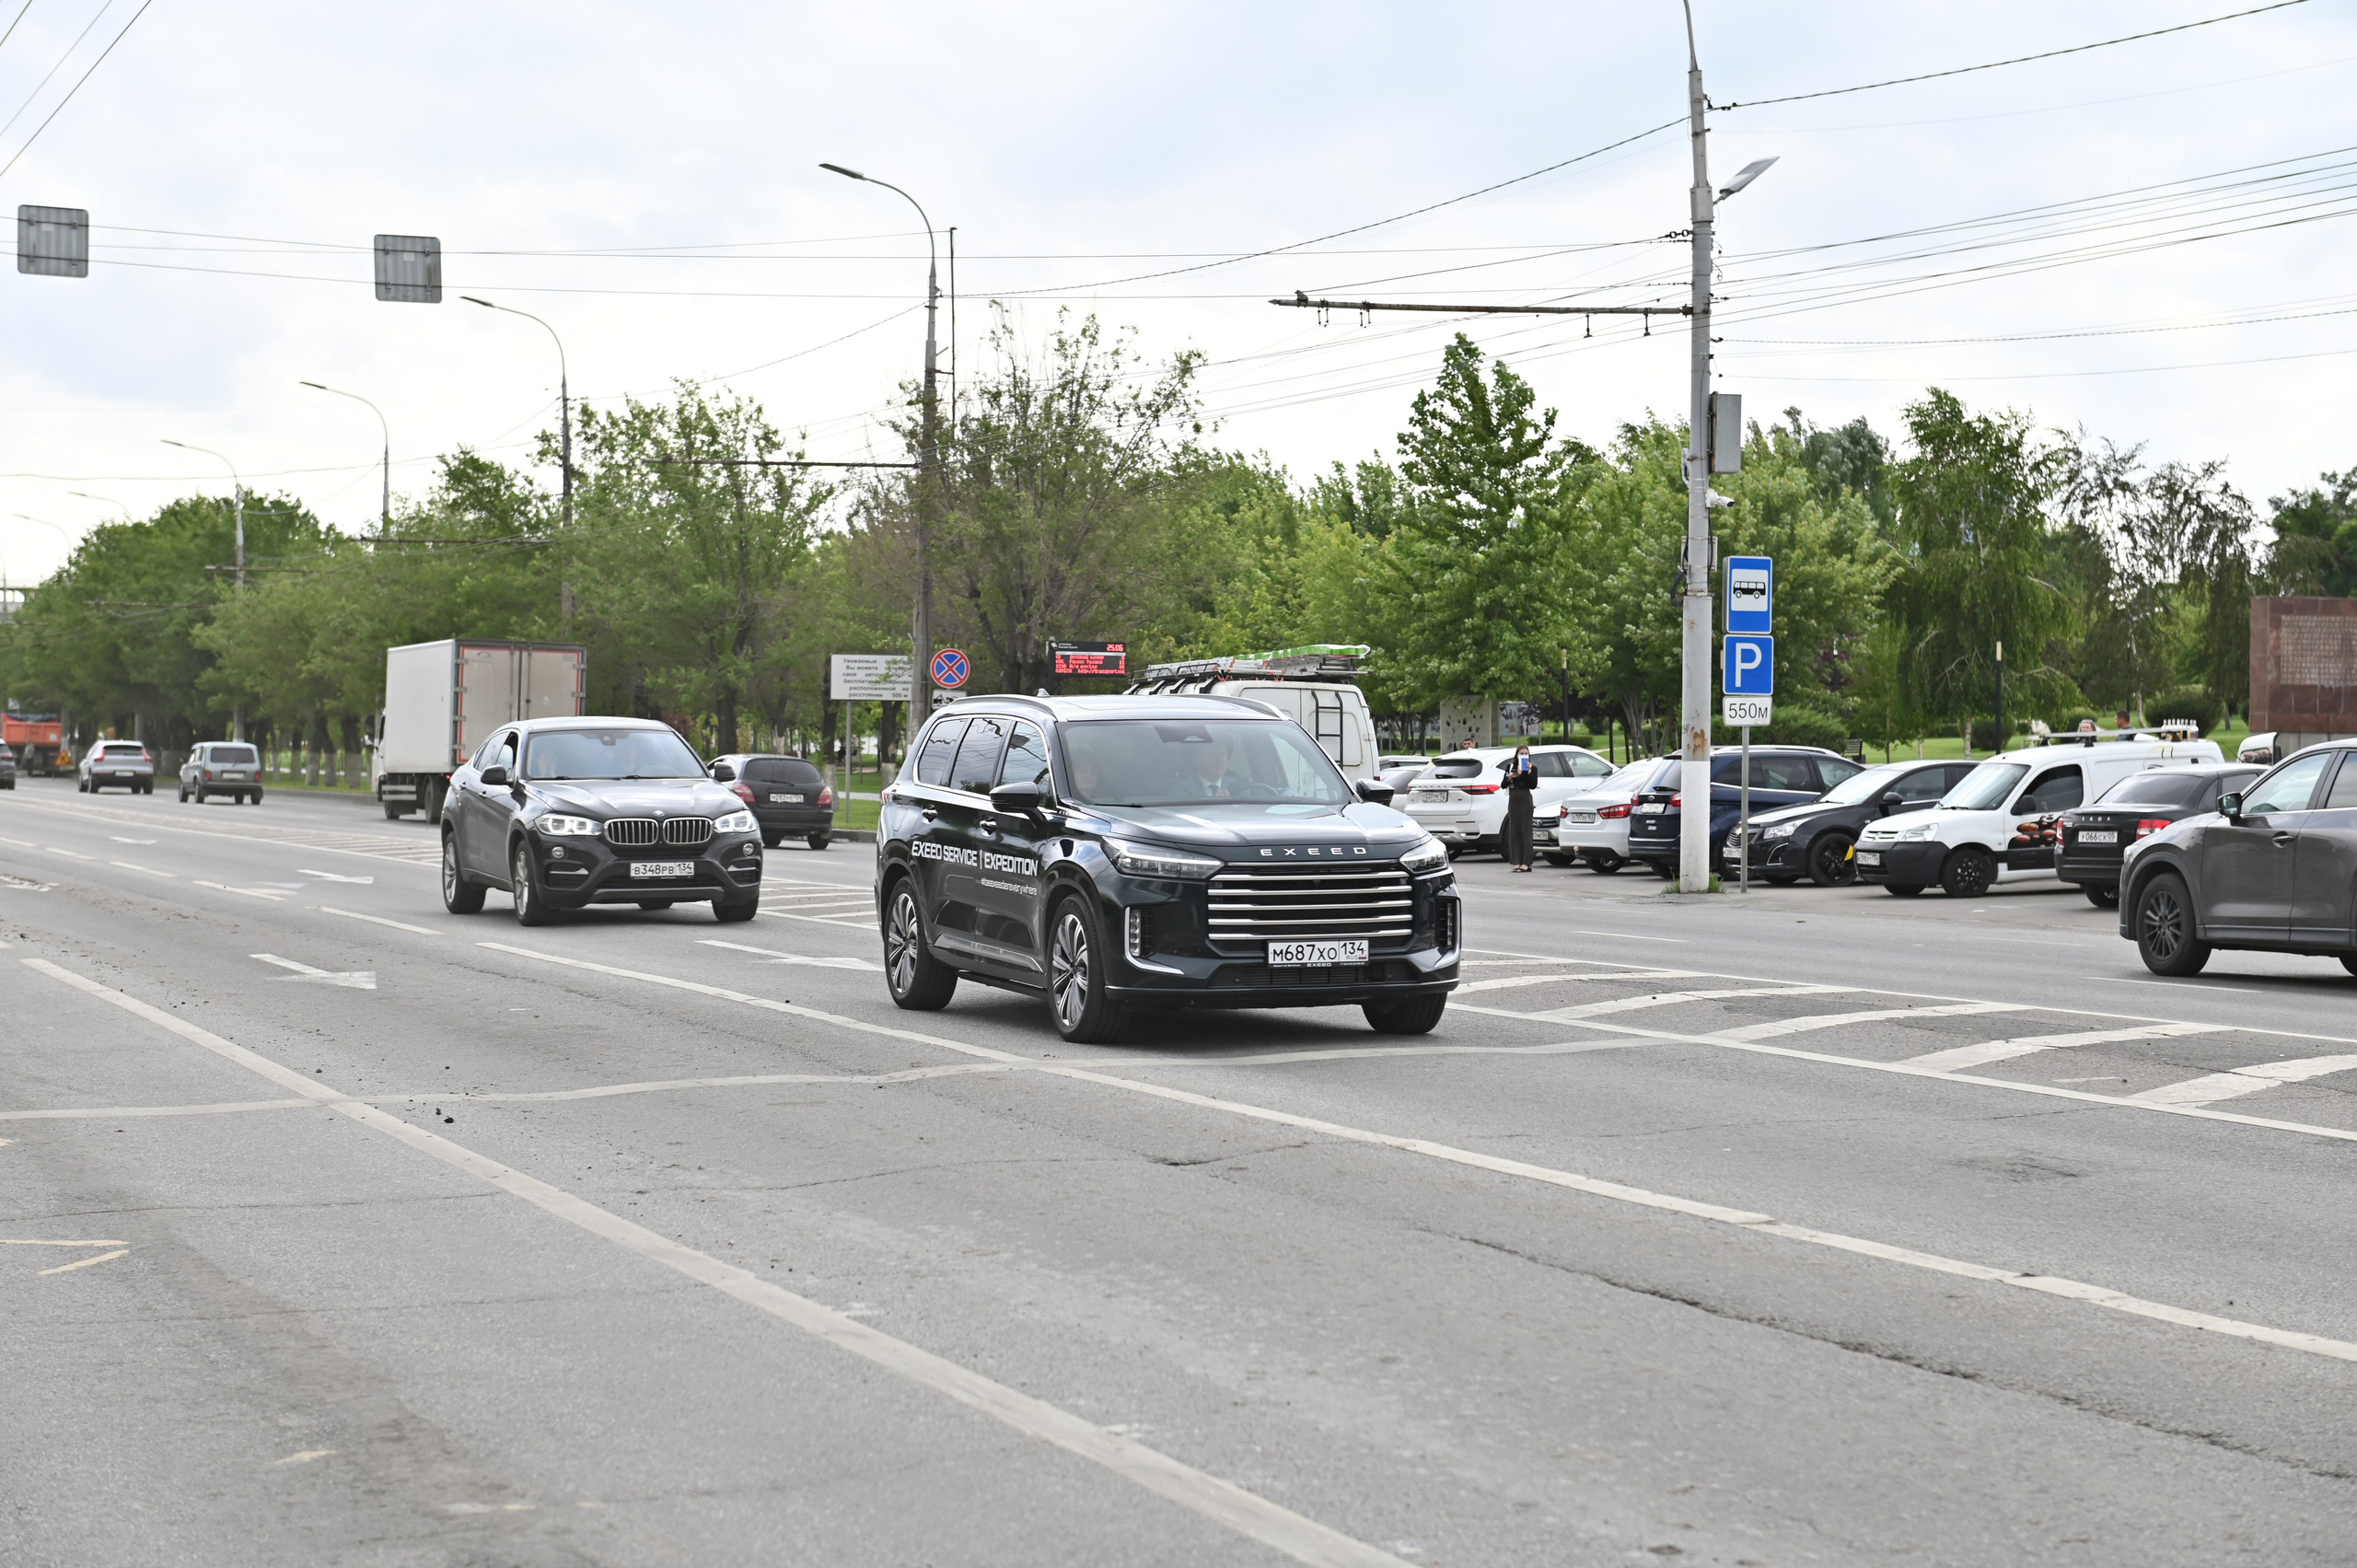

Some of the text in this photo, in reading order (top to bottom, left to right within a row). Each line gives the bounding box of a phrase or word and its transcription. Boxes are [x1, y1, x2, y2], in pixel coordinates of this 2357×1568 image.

[1736, 643, 1762, 687] P
[911, 841, 1038, 877] EXEED SERVICE EXPEDITION
[1260, 847, 1366, 856] EXEED
[1341, 941, 1364, 955] 134
